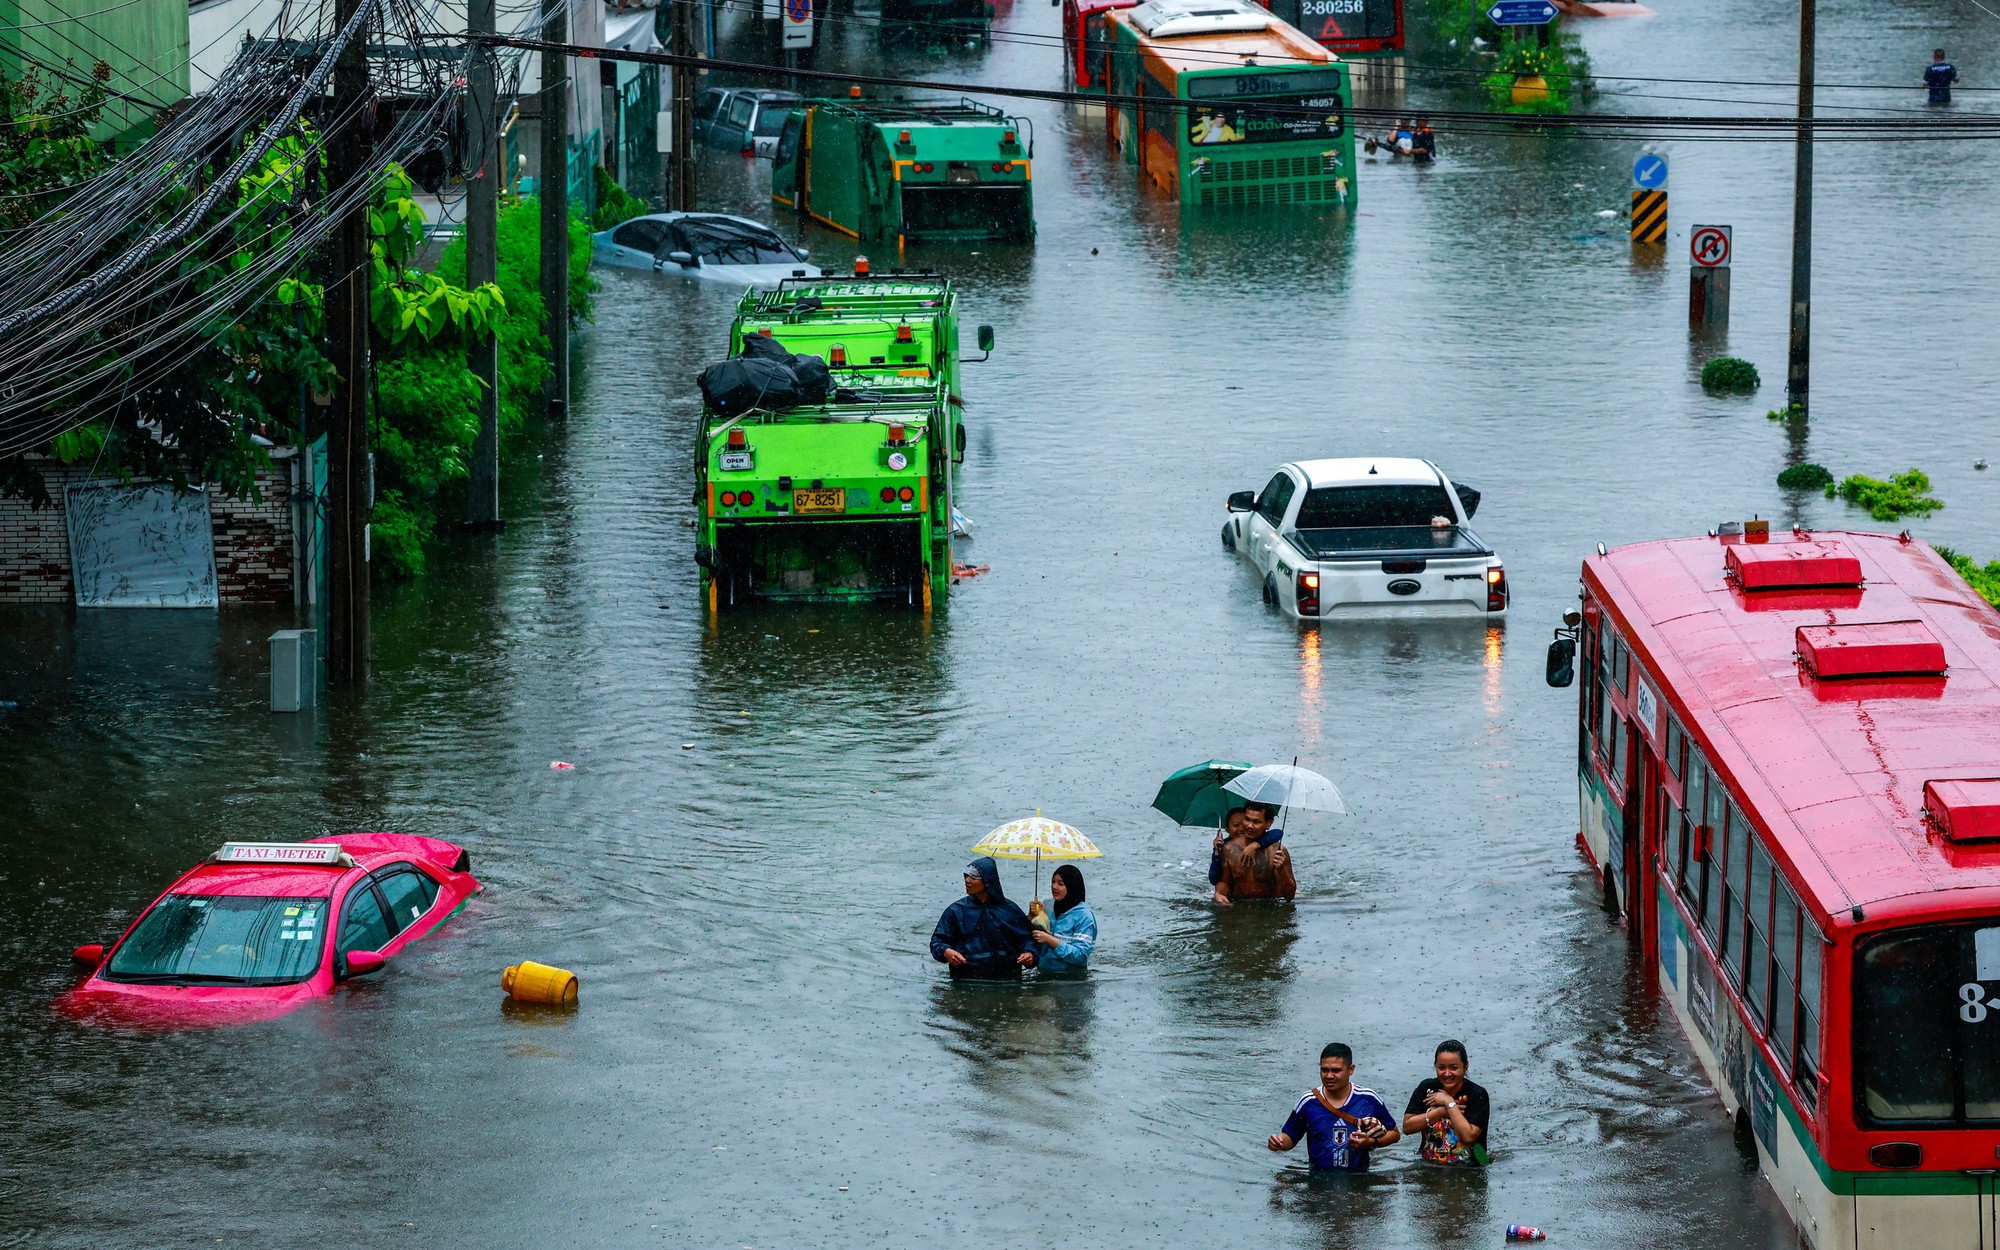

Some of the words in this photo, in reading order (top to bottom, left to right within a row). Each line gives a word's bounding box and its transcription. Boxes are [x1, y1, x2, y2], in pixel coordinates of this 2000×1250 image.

[1302, 0, 1363, 14] 2-80256
[1300, 98, 1334, 107] 1-45057
[796, 494, 840, 506] 67-8251
[234, 848, 327, 859] TAXI-METER
[1333, 1148, 1348, 1167] 10
